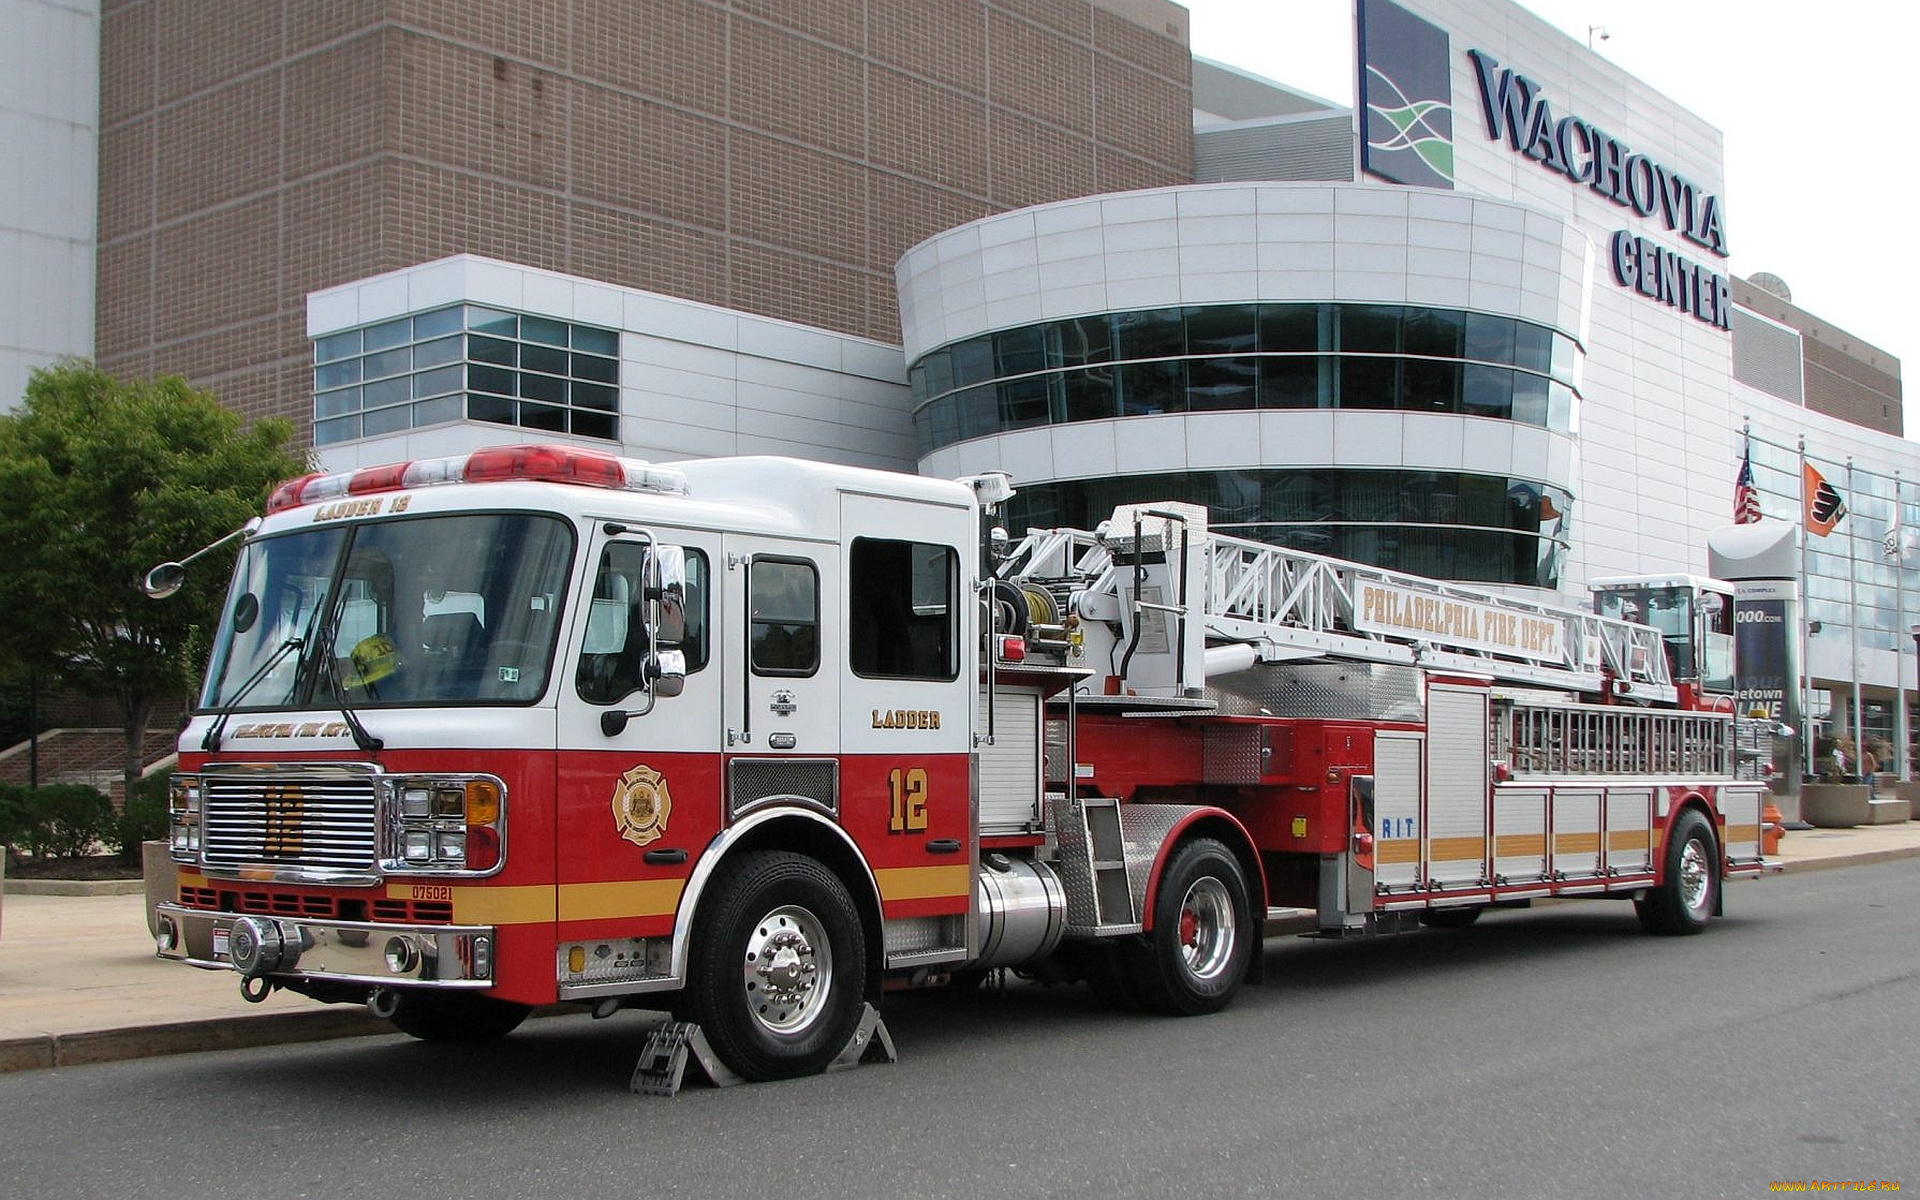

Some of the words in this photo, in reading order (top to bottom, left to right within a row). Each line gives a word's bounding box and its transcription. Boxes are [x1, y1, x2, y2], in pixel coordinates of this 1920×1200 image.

[1467, 48, 1729, 257] WACHOVIA
[1611, 229, 1732, 330] CENTER
[1364, 586, 1479, 639] PHILADELPHIA
[1484, 610, 1516, 646] FIRE
[1521, 617, 1557, 654] DEPT.
[872, 709, 940, 729] LADDER
[889, 768, 928, 834] 12
[1382, 818, 1413, 838] RIT
[412, 886, 453, 900] 075021
